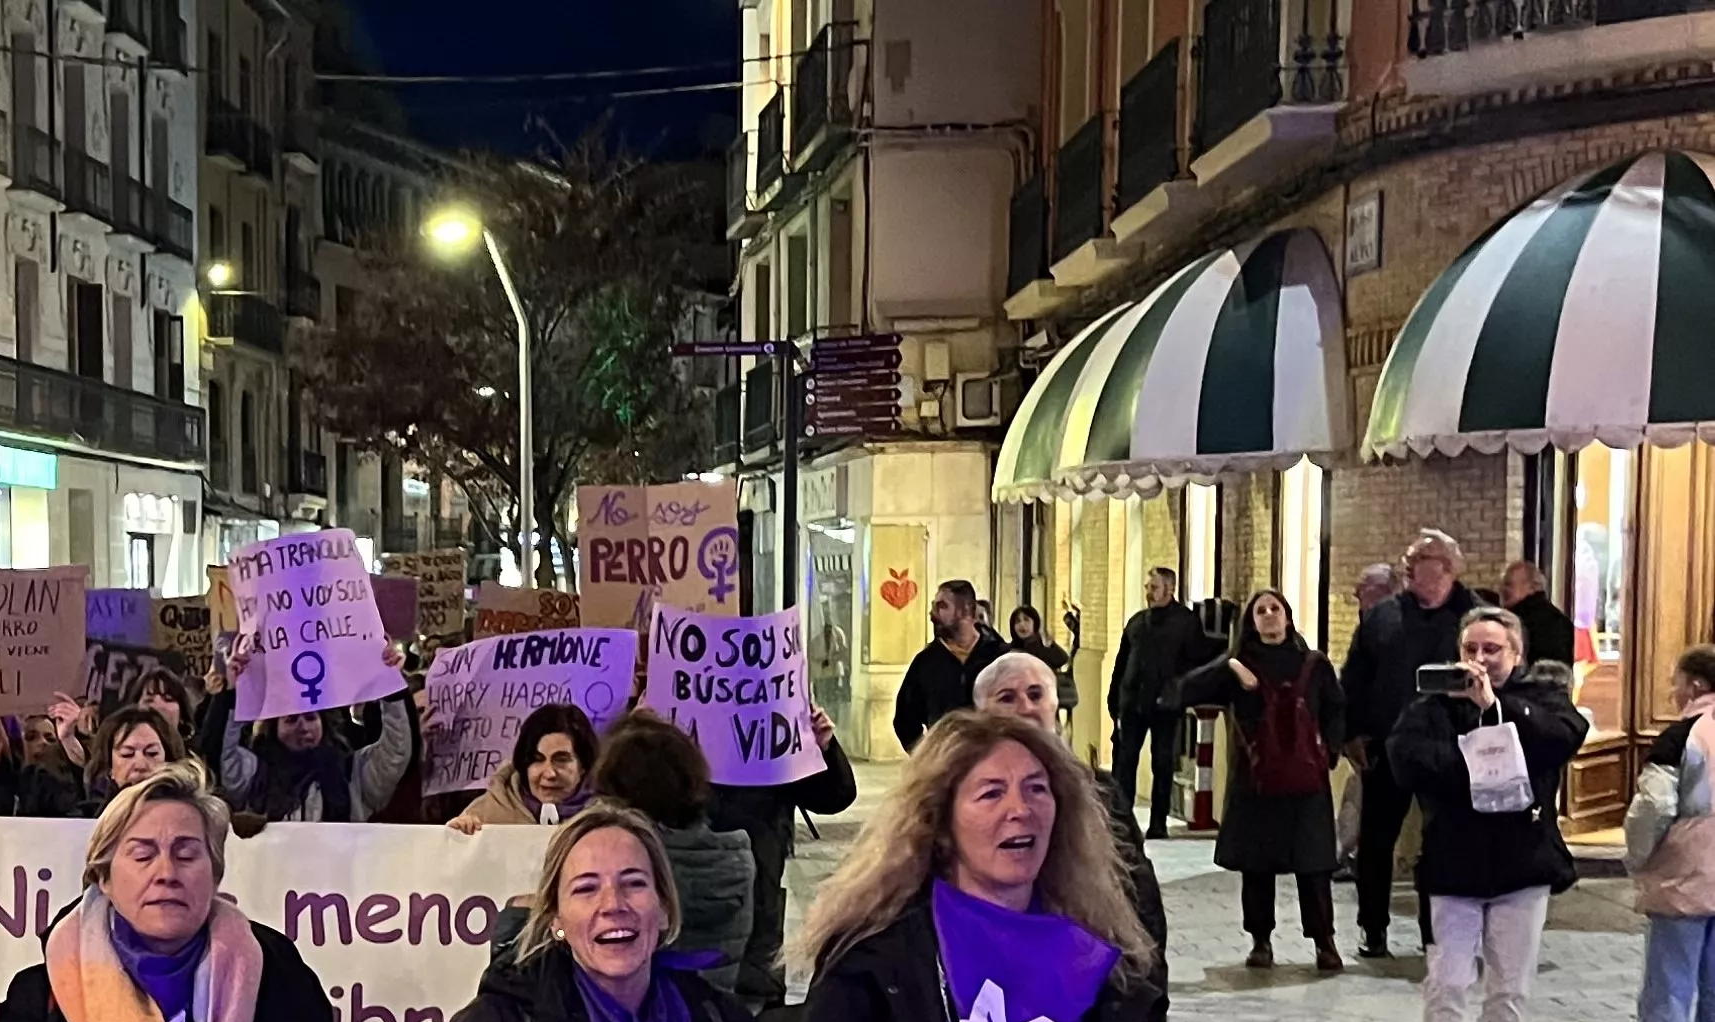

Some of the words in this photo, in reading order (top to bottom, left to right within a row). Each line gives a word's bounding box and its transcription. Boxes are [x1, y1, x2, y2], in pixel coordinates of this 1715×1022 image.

[587, 492, 637, 526] No
[276, 539, 355, 570] TRANQUILA
[590, 536, 689, 585] PERRO
[267, 589, 293, 612] NO
[300, 583, 332, 607] VOY
[336, 579, 369, 602] SOLA
[268, 626, 290, 650] LA
[655, 611, 707, 662] NO
[716, 625, 776, 669] SOY
[432, 647, 475, 678] SIN
[500, 677, 573, 709] HABRÍA
[673, 666, 795, 704] BÚSCATE
[285, 889, 492, 947] meno
